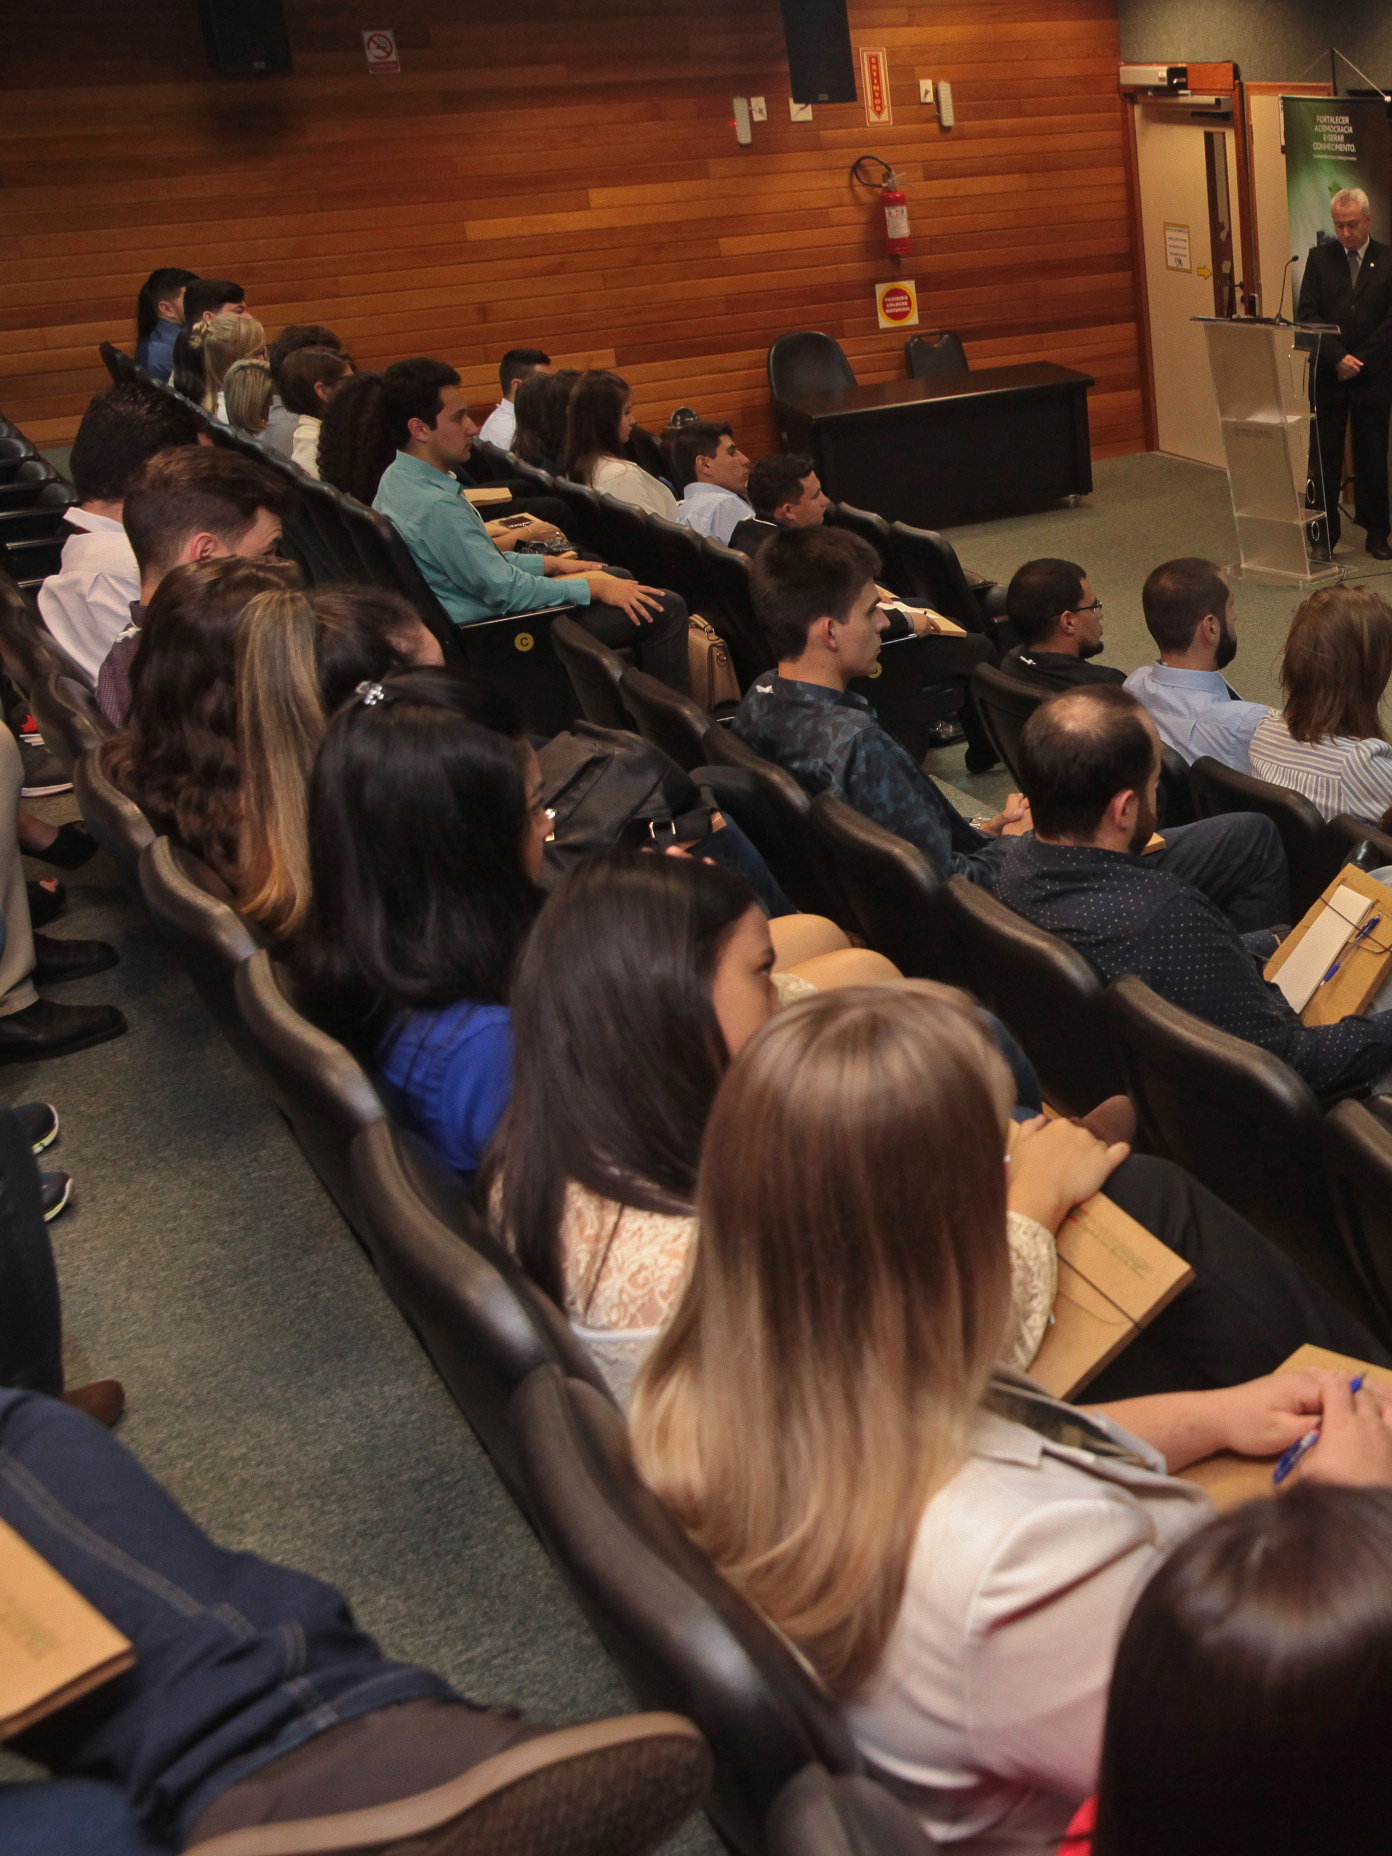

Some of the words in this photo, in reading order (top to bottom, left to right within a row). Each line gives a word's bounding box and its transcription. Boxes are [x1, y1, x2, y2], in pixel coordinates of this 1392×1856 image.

[871, 57, 881, 111] EXTINTOR
[1317, 115, 1349, 124] FORTALECER
[1318, 125, 1353, 134] DEMOCRACIA
[1327, 134, 1344, 143] GERAR
[520, 637, 529, 647] C
